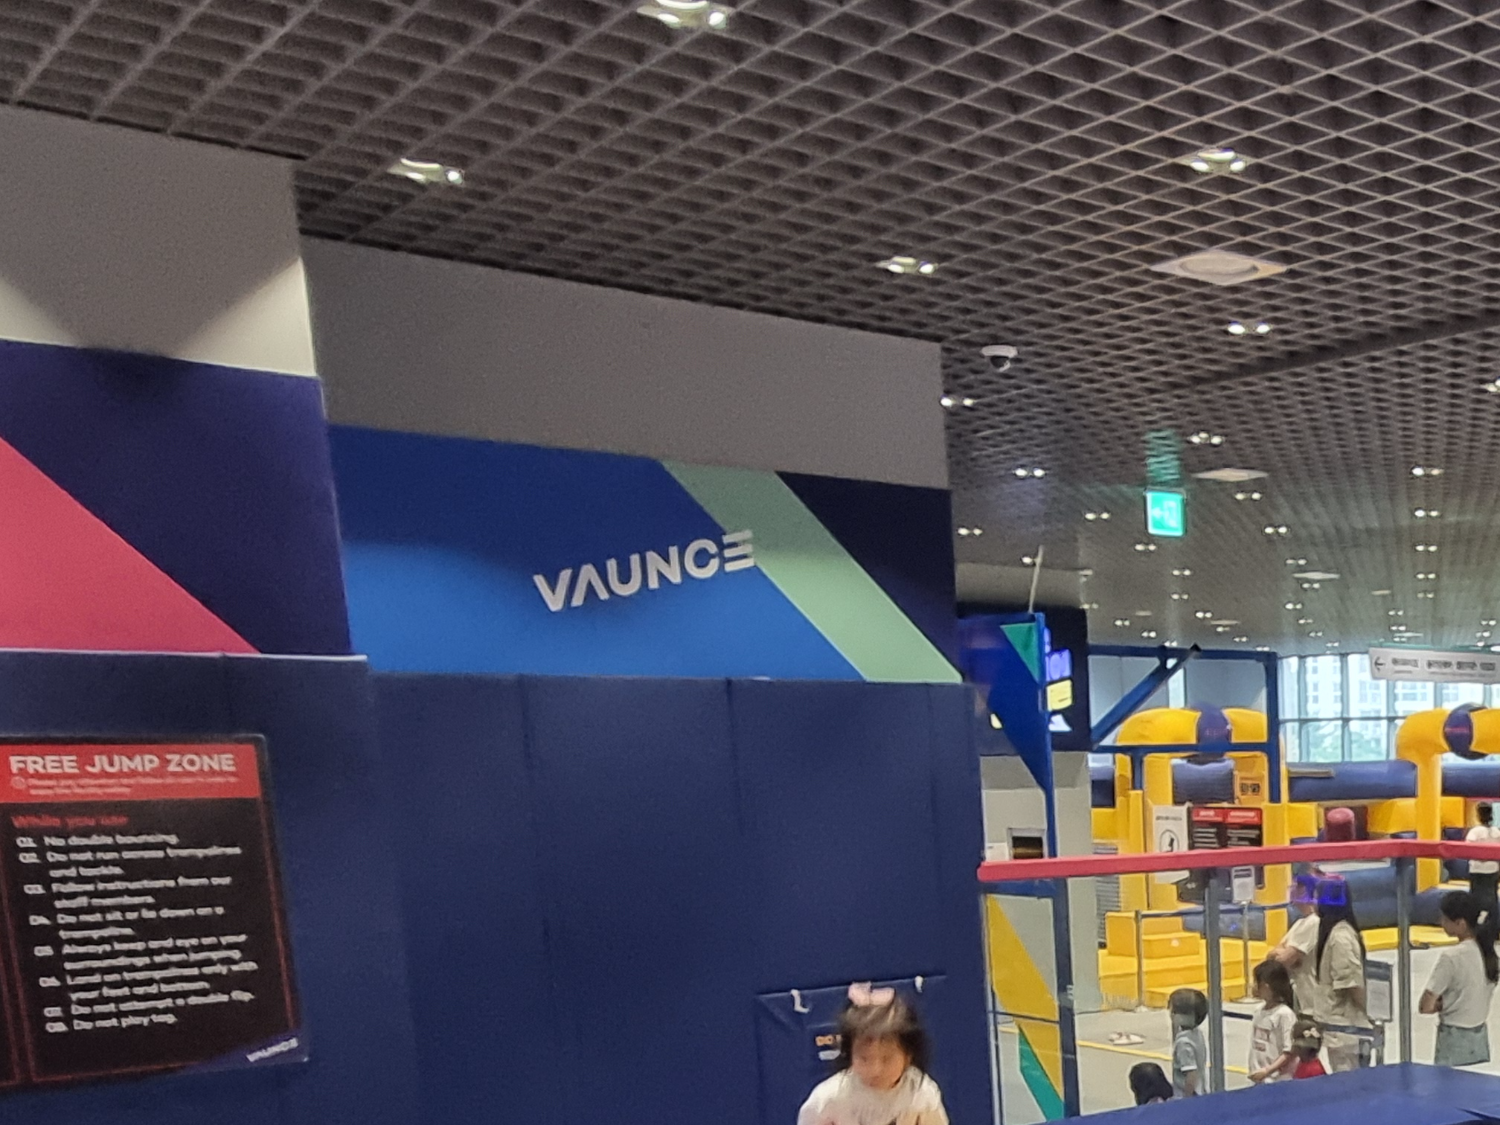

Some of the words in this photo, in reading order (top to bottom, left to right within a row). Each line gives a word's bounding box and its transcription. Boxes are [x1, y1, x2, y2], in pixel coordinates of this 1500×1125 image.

[533, 529, 755, 612] VAUNCE
[9, 755, 79, 773] FREE
[85, 755, 159, 773] JUMP
[165, 754, 236, 772] ZONE
